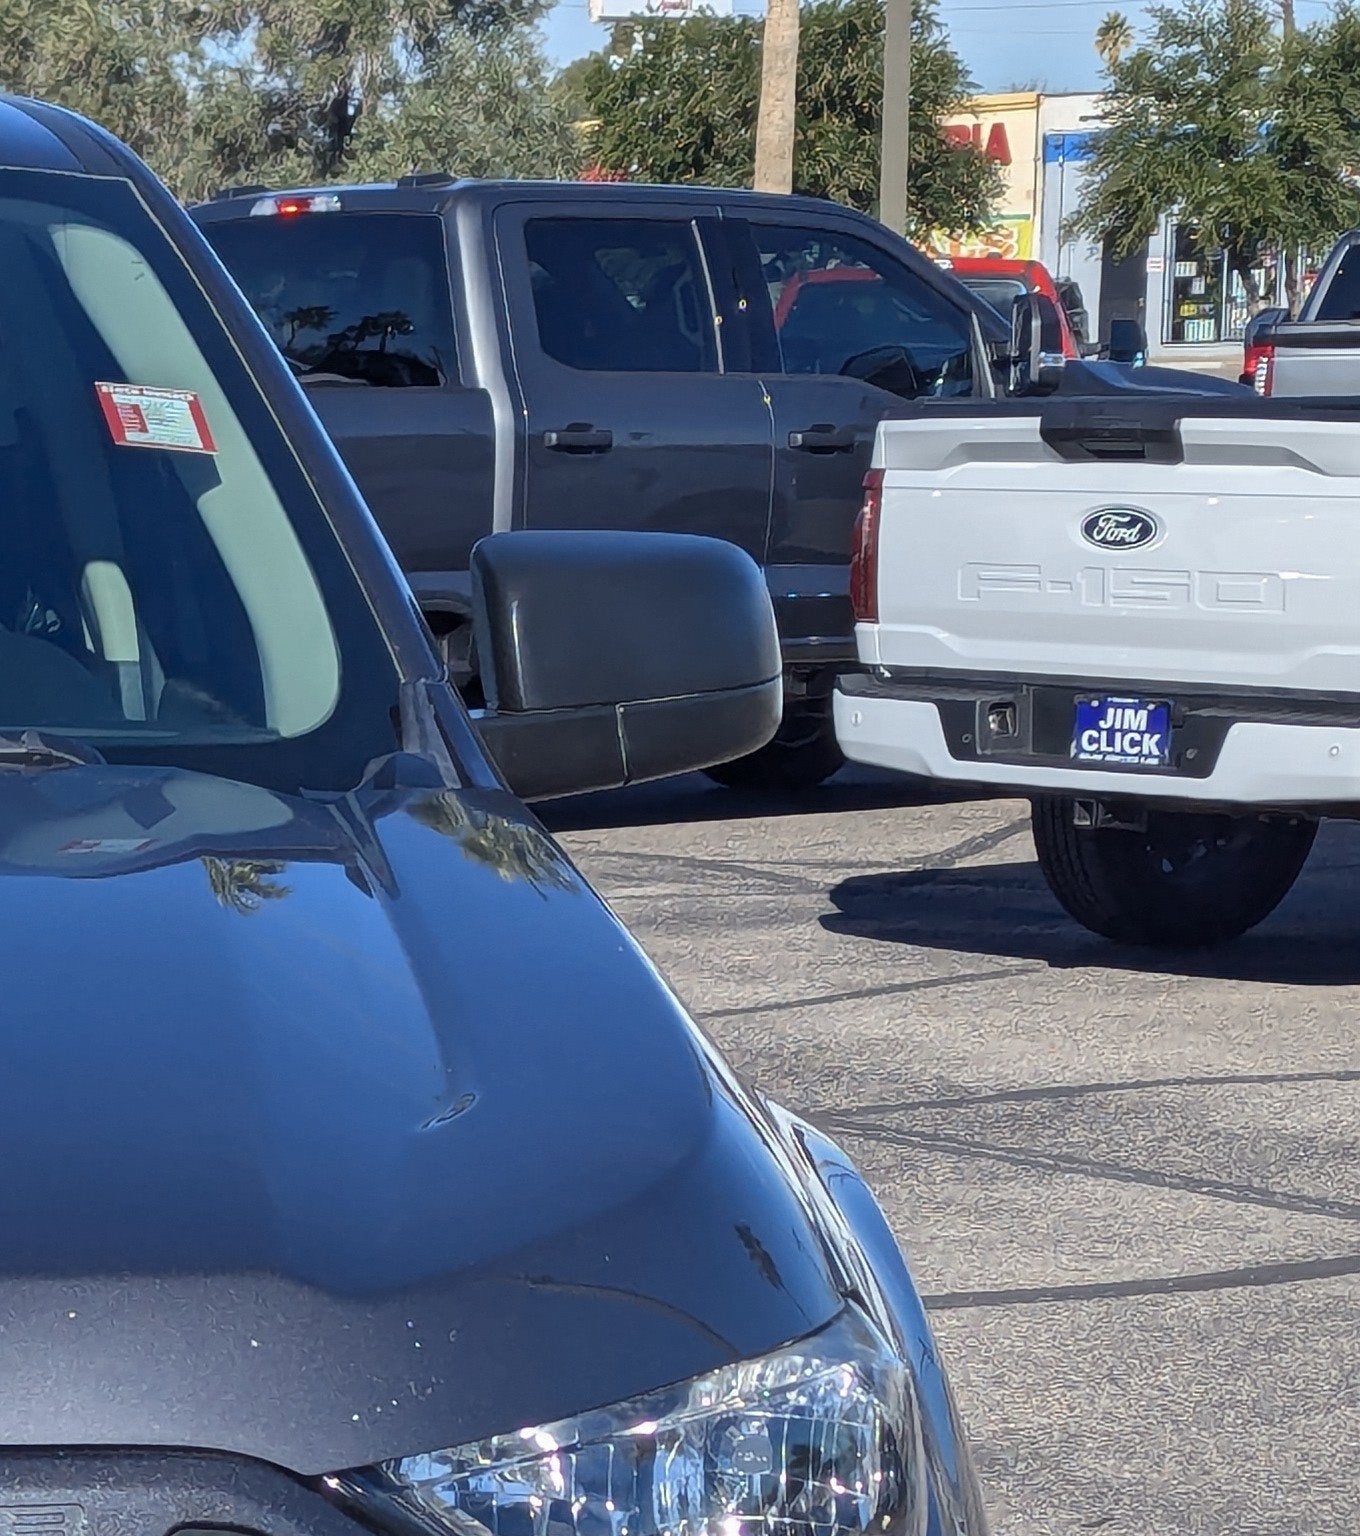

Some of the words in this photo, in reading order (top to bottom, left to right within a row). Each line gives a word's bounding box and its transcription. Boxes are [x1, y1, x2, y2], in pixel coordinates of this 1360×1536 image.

[1092, 514, 1143, 545] Ford
[957, 561, 1286, 612] F-150
[1098, 707, 1149, 731] JIM
[1081, 729, 1162, 756] CLICK
